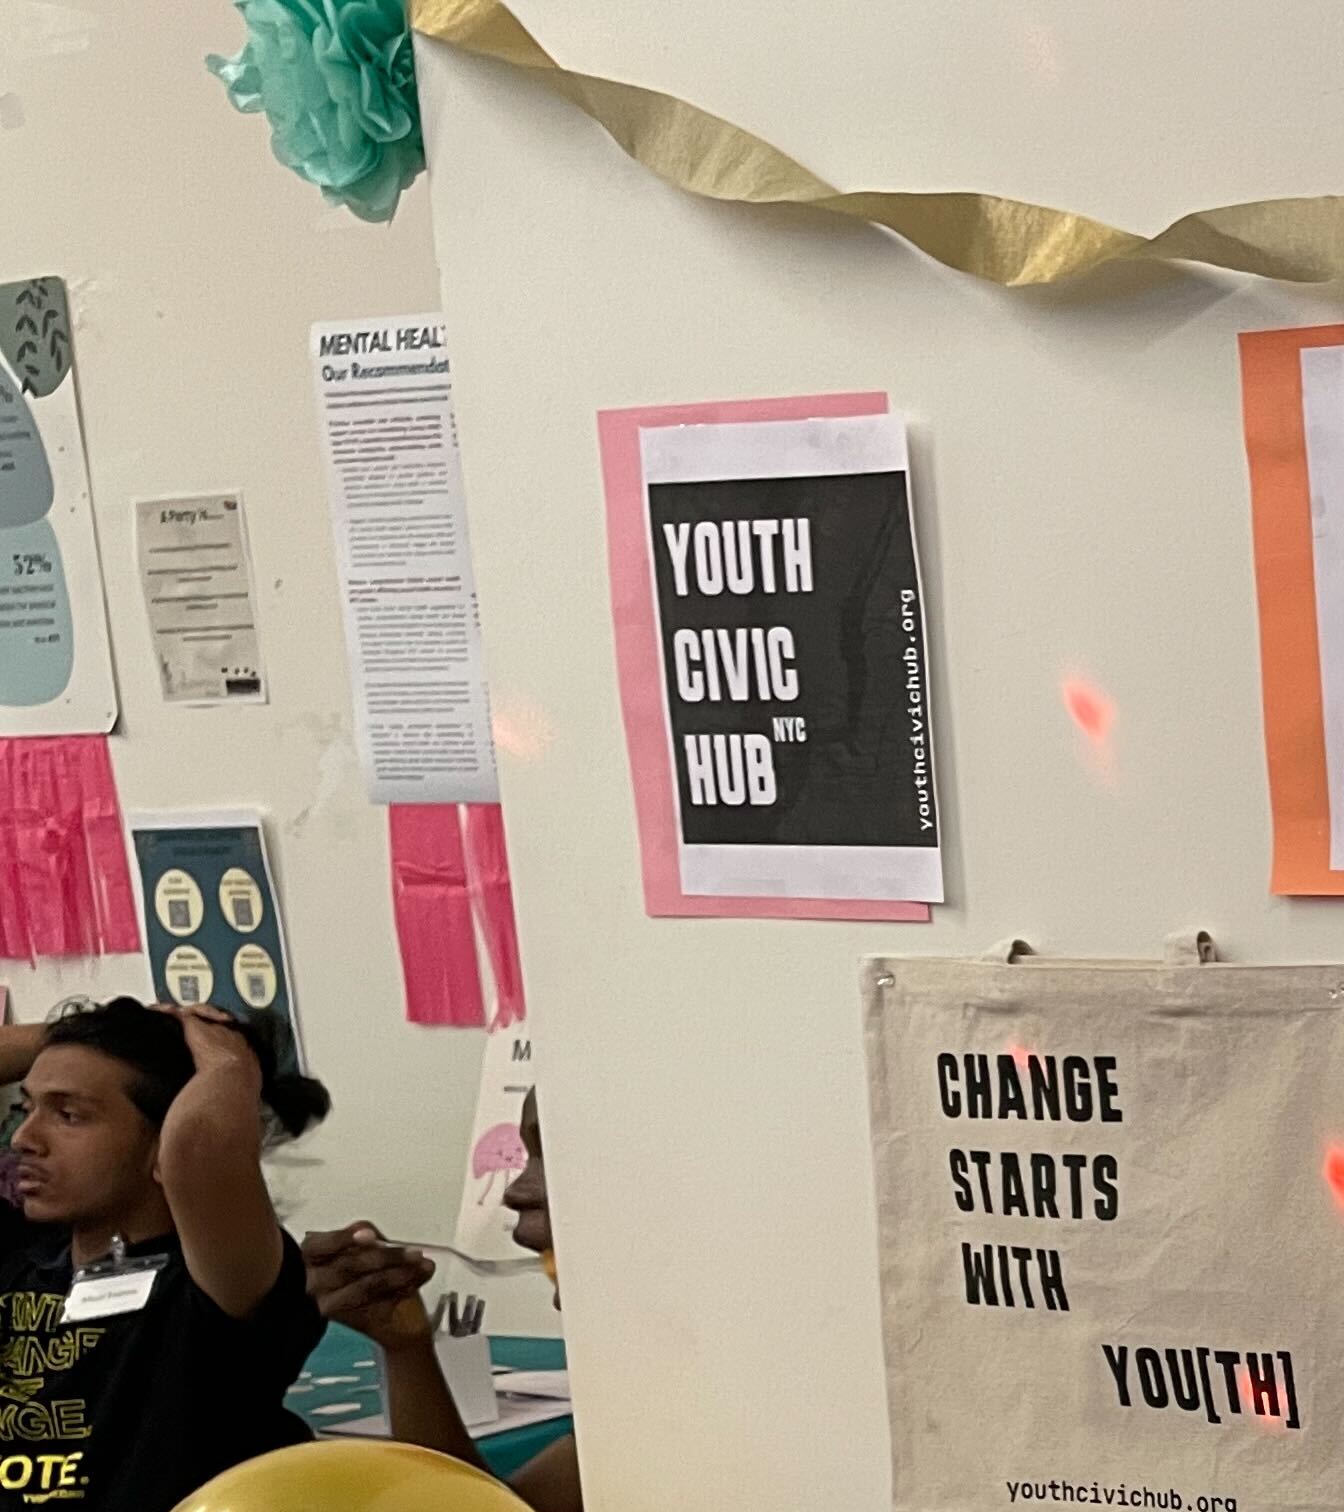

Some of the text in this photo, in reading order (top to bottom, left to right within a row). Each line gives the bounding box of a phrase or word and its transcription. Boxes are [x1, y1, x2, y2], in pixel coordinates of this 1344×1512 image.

[319, 324, 446, 357] MENTAL HEAL
[663, 518, 814, 596] YOUTH
[673, 627, 799, 701] CIVIC
[900, 589, 934, 831] youthcivichub.org
[684, 717, 807, 805] HUB NYC
[937, 1052, 1123, 1122] CHANGE
[949, 1148, 1118, 1221] STARTS
[961, 1243, 1070, 1312] WITH
[1102, 1344, 1301, 1429] YOU[TH]
[0, 1451, 91, 1489] OTE.
